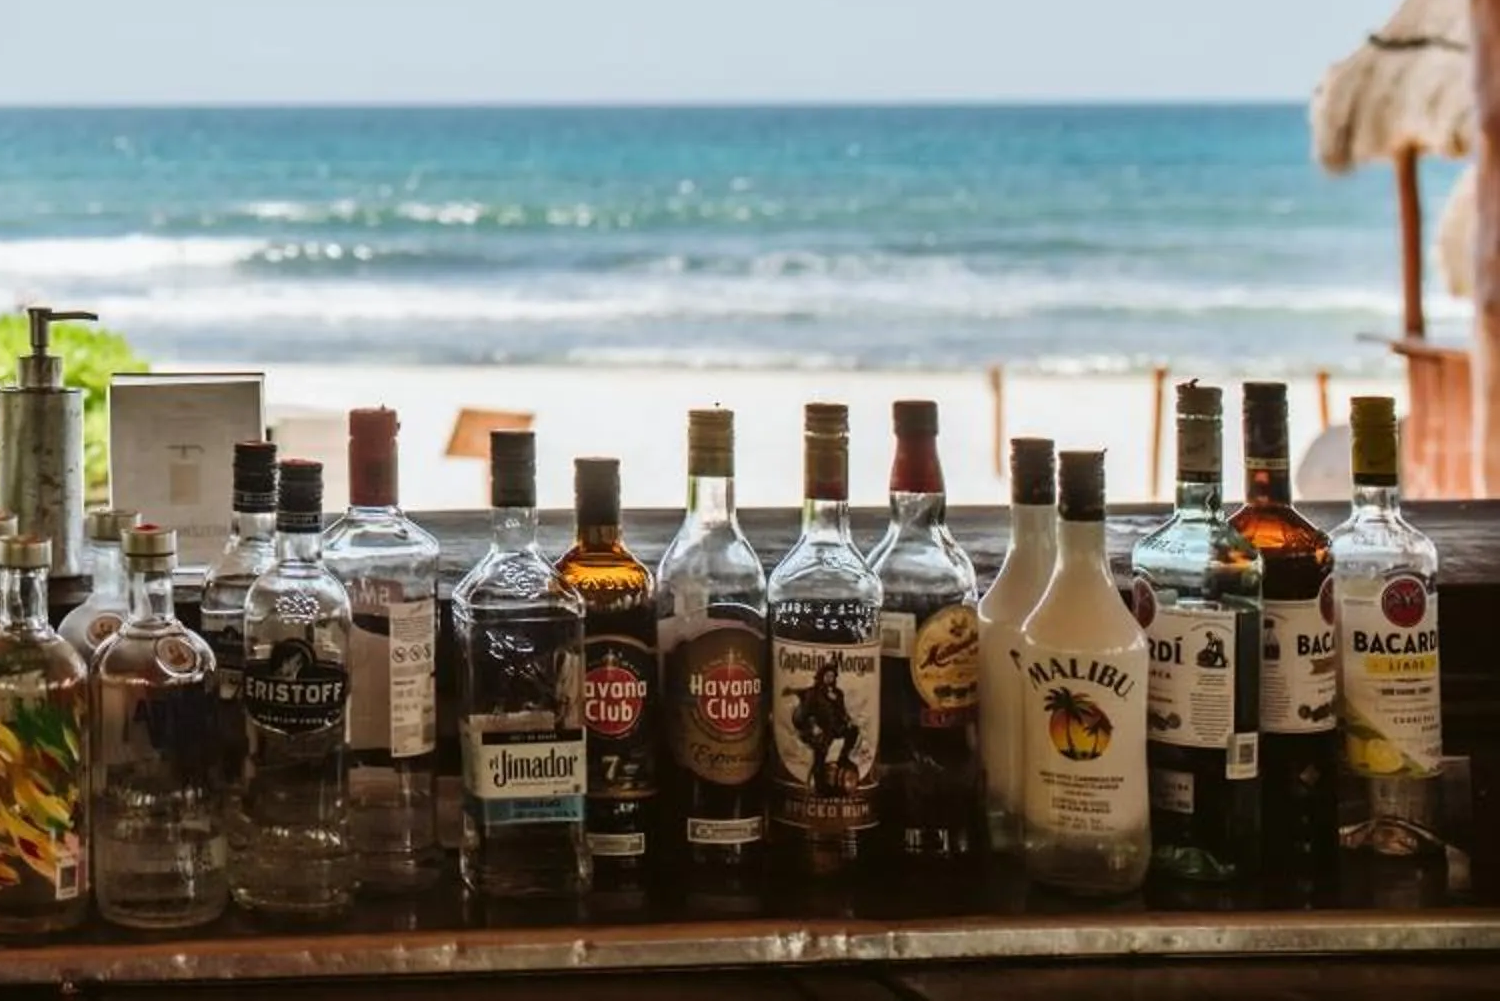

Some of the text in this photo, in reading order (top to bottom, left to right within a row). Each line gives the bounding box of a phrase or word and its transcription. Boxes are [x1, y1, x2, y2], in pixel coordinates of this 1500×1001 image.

[778, 646, 875, 677] Captain Morgan
[245, 676, 343, 705] ERISTOFF
[584, 679, 647, 699] avana
[689, 673, 762, 696] Havana
[1027, 656, 1135, 700] MALIBU
[585, 699, 634, 722] Club
[706, 698, 751, 720] Club
[493, 747, 579, 788] Jimador
[601, 755, 620, 780] 7
